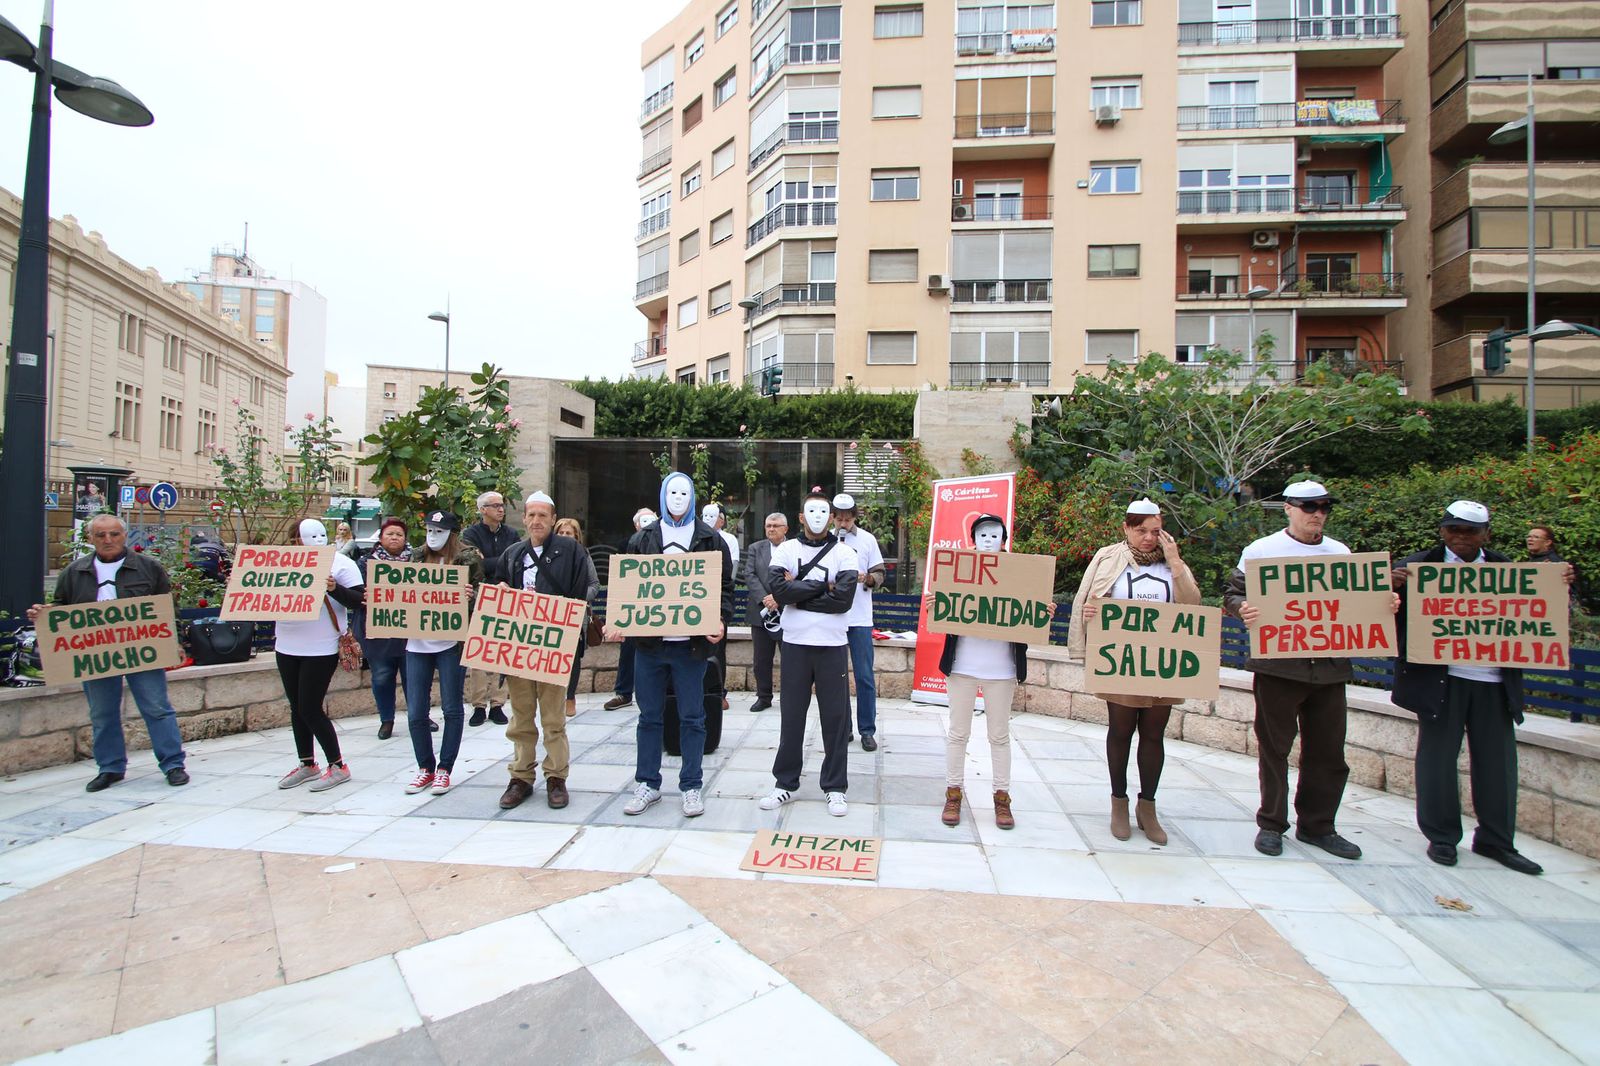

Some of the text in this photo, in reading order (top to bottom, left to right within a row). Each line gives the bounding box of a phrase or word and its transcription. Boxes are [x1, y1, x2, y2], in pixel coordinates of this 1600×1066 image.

[124, 489, 131, 501] P
[238, 549, 318, 568] PORQUE
[620, 559, 706, 578] PORQUE
[933, 550, 998, 585] POR
[241, 571, 314, 588] QUIERO
[374, 564, 458, 585] PORQUE
[1259, 561, 1390, 595] PORQUE
[1418, 566, 1538, 595] PORQUE
[229, 592, 315, 612] TRABAJAR
[374, 588, 461, 604] EN LA CALLE
[637, 582, 707, 599] NO ES
[48, 602, 157, 633] PORQUE
[373, 608, 462, 631] HACE FRIO
[478, 586, 584, 627] PORQUE
[614, 604, 702, 628] JUSTO
[934, 591, 1050, 628] DIGNIDAD
[1284, 600, 1339, 621] SOY
[1422, 598, 1547, 618] NECESITO
[481, 615, 563, 648] TENGO
[1102, 604, 1205, 637] POR MI
[54, 623, 172, 652] AGUANTAMOS
[1259, 624, 1389, 654] PERSONA
[74, 646, 157, 678] MUCHO
[466, 636, 573, 674] DERECHOS
[1094, 643, 1199, 679] SALUD
[1434, 638, 1566, 667] FAMILIA
[771, 833, 875, 852] HAZME
[753, 850, 874, 872] VISIBLE
